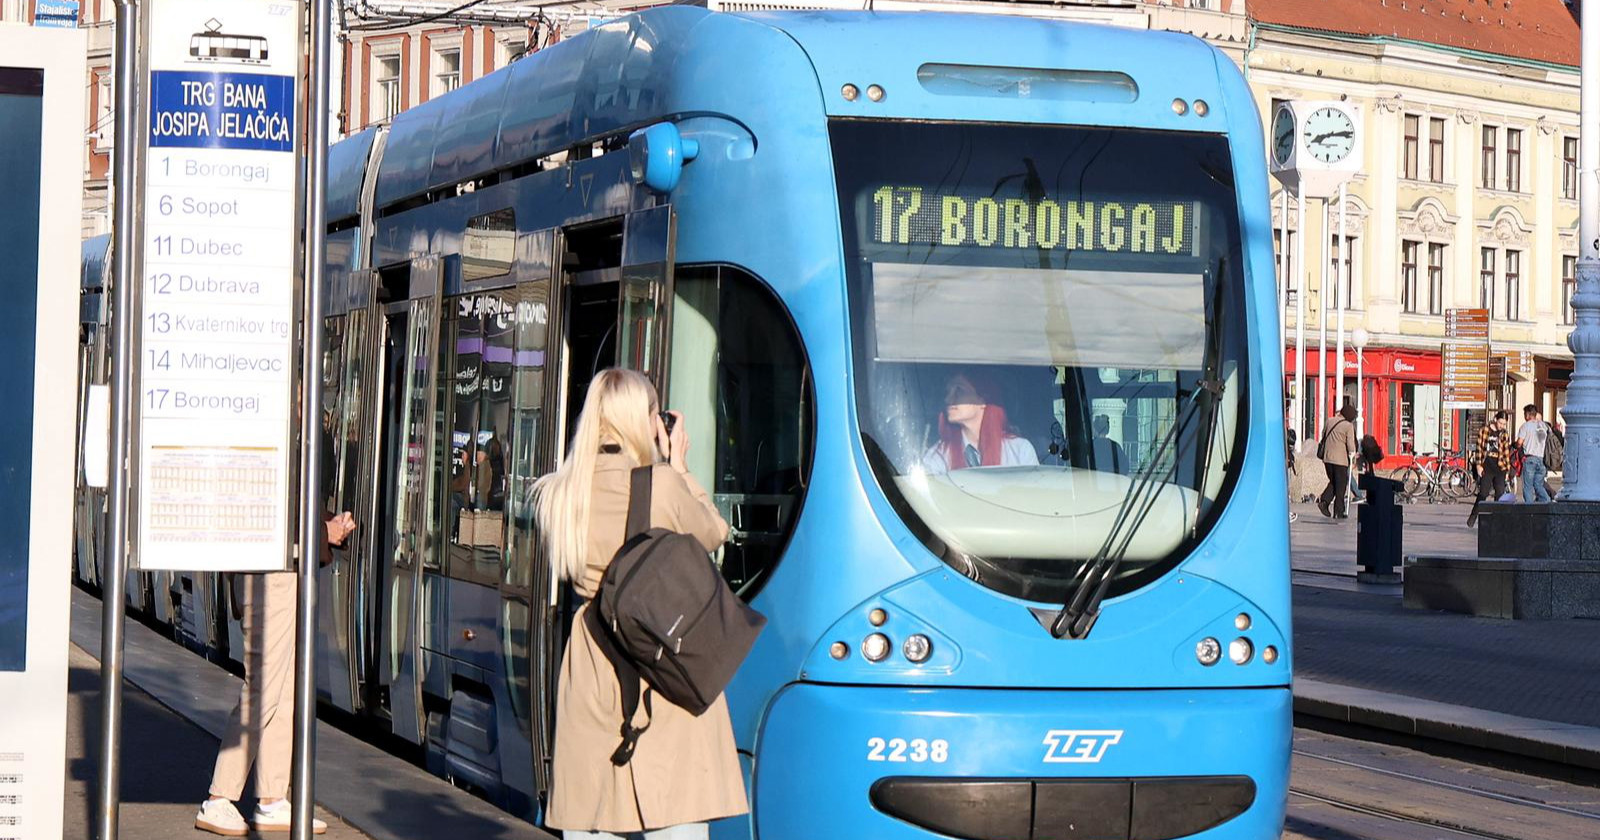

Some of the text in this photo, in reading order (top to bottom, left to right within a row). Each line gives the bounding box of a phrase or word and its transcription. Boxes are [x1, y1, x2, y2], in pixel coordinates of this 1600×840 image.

[181, 80, 267, 109] TRG BANA
[152, 110, 290, 142] JOSIPA JELAČIĆA
[161, 156, 270, 182] 1 Borongaj
[159, 195, 239, 218] 6 Sopot
[873, 186, 1185, 254] 17 BORONGAJ
[153, 235, 243, 257] 11 Dubec
[149, 273, 260, 295] 12 Dubrava
[148, 312, 289, 338] 13 Kvaternikov trg
[149, 350, 282, 373] 14 Mihaljevac
[146, 388, 260, 413] 17 Borongaj
[866, 737, 949, 763] 2238
[1042, 729, 1124, 763] ZET
